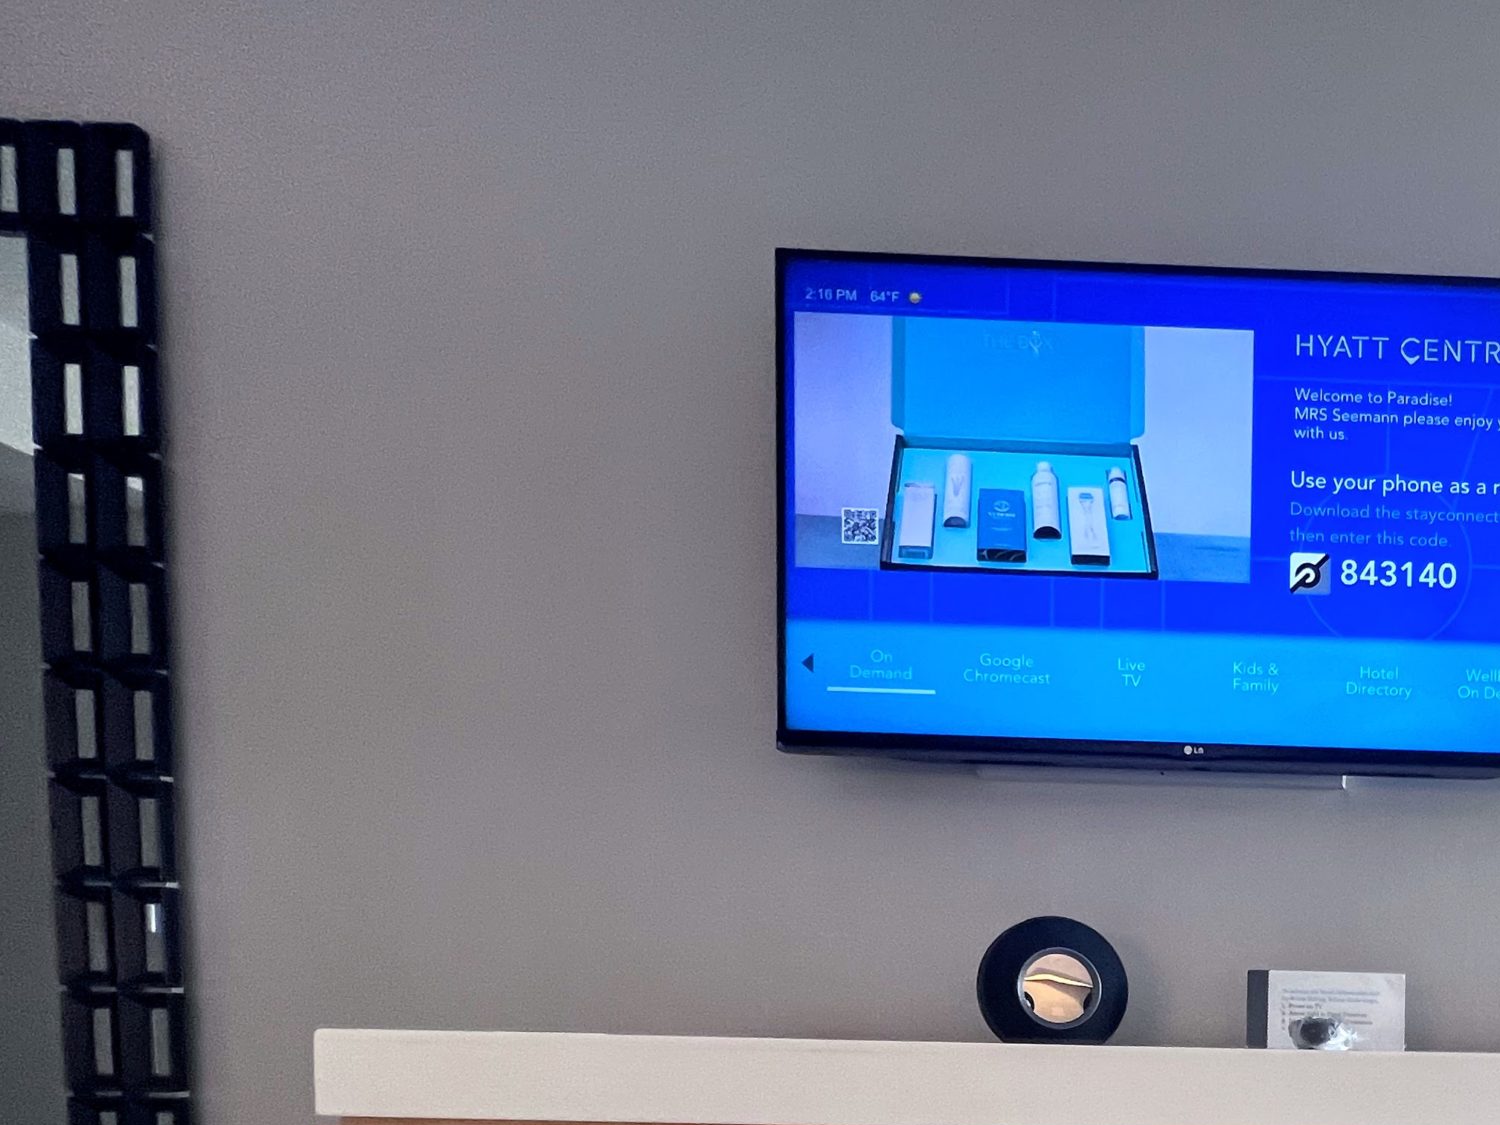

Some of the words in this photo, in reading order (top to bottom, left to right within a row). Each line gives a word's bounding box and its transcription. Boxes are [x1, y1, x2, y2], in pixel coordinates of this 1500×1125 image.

[836, 288, 857, 301] PM
[1296, 334, 1390, 359] HYATT
[1294, 387, 1363, 404] Welcome
[1368, 391, 1383, 404] to
[1388, 390, 1453, 406] Paradise!
[1294, 407, 1328, 421] MRS
[1333, 408, 1399, 424] Seemann
[1403, 411, 1450, 428] please
[1454, 413, 1493, 430] enjoy
[1294, 426, 1324, 440] with
[1291, 470, 1327, 489] Use
[1333, 476, 1376, 495] your
[1382, 474, 1443, 496] phone
[1450, 480, 1470, 494] as
[1476, 482, 1486, 495] a
[1290, 502, 1370, 519] Download
[1375, 505, 1400, 520] the
[1290, 529, 1325, 543] then
[1330, 531, 1370, 544] enter
[1376, 531, 1404, 546] this
[1340, 559, 1457, 588] 843140
[870, 649, 893, 664] On
[979, 653, 1034, 670] Google
[1118, 657, 1146, 672] Live
[849, 665, 912, 681] Demand
[963, 668, 1050, 685] Chromecast
[1233, 661, 1264, 676] Kids
[1268, 663, 1279, 676] &
[1360, 665, 1399, 681] Hotel
[1122, 673, 1142, 688] TV
[1233, 678, 1280, 695] Family
[1346, 681, 1413, 699] Directory
[1458, 685, 1480, 699] On
